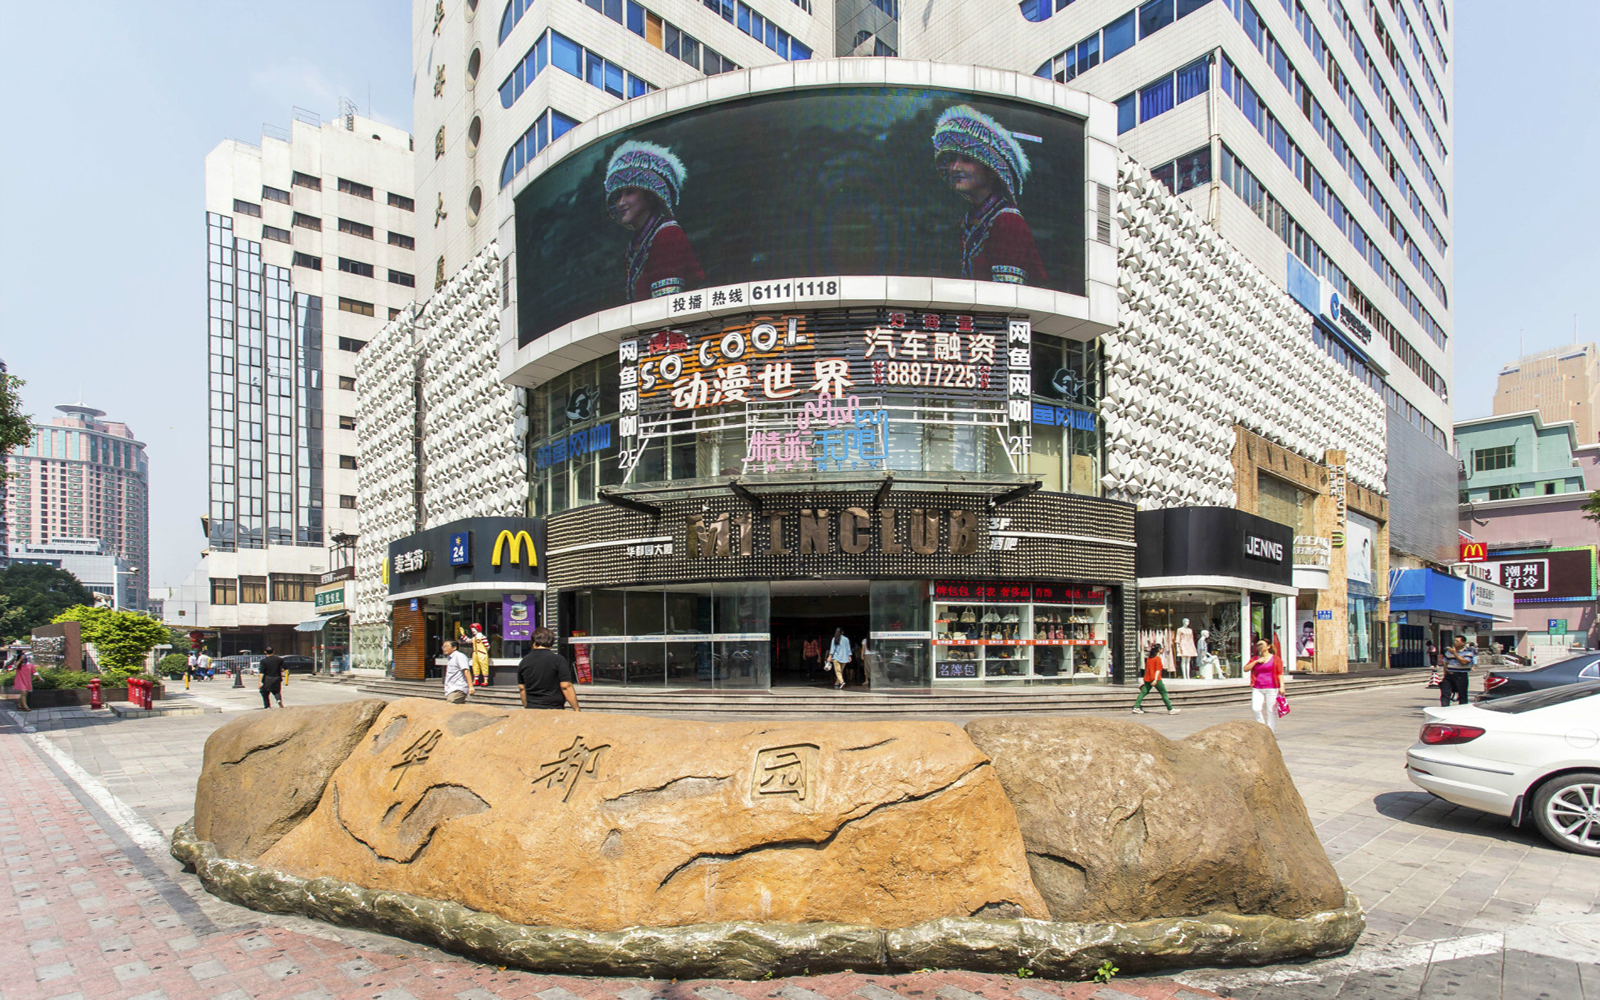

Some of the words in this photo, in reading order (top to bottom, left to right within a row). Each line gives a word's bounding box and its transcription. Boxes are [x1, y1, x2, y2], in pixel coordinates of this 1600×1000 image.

[752, 281, 837, 301] 61111118
[888, 312, 974, 332] 好商量
[698, 316, 809, 370] COOL
[864, 327, 996, 365] 汽车融资
[887, 361, 977, 388] 88877225
[1008, 320, 1032, 422] 网鱼网咖
[618, 340, 639, 437] 网鱼网咖
[671, 359, 856, 409] 动漫世界
[1009, 435, 1033, 455] 2F
[988, 517, 1011, 530] 3F
[453, 545, 465, 558] 24
[1245, 536, 1283, 562] JENNS
[393, 548, 424, 574] 麦当劳
[1504, 564, 1539, 577] 潮州
[1001, 586, 1030, 598] 奢侈品
[1504, 576, 1539, 588] 打冷
[938, 663, 976, 677] 名牌包
